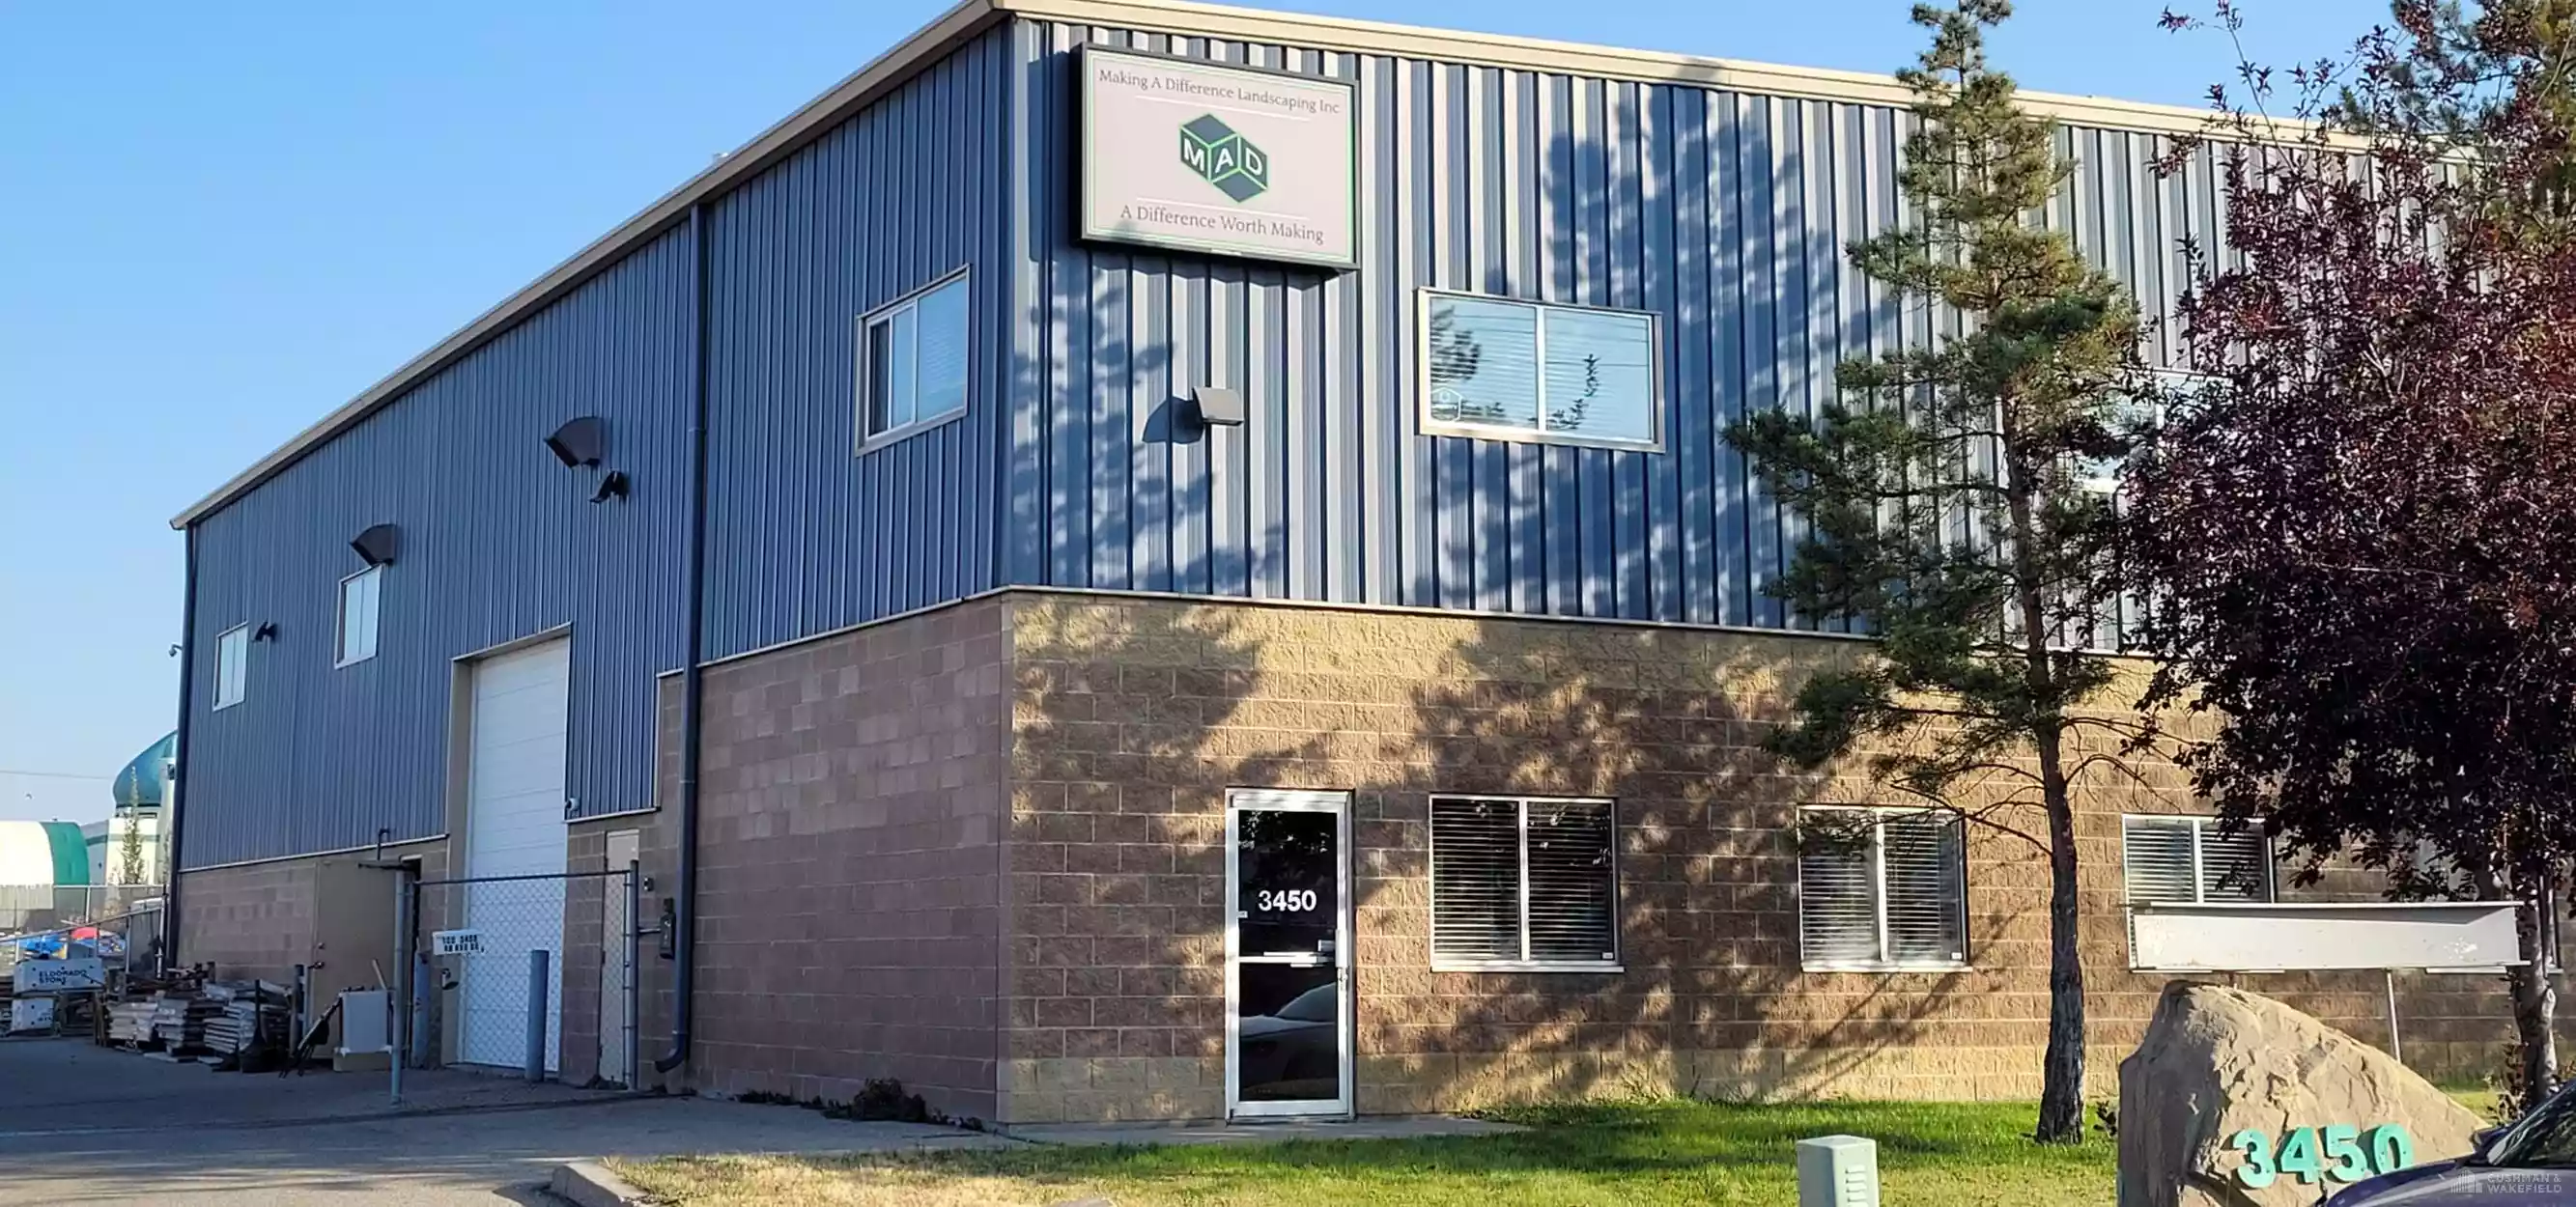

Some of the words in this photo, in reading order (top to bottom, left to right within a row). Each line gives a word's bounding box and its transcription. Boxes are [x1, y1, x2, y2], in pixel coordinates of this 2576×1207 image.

[1099, 69, 1148, 90] Making
[1151, 76, 1163, 89] A
[1165, 77, 1234, 98] Difference
[1237, 87, 1317, 113] Landscaping
[1319, 98, 1340, 114] Inc
[1183, 138, 1263, 176] MAD
[1120, 205, 1133, 219] A
[1137, 206, 1216, 230] Difference
[1220, 214, 1267, 236] Worth
[1271, 222, 1324, 245] Making
[1259, 889, 1317, 912] 3450
[2232, 1123, 2417, 1189] 3450
